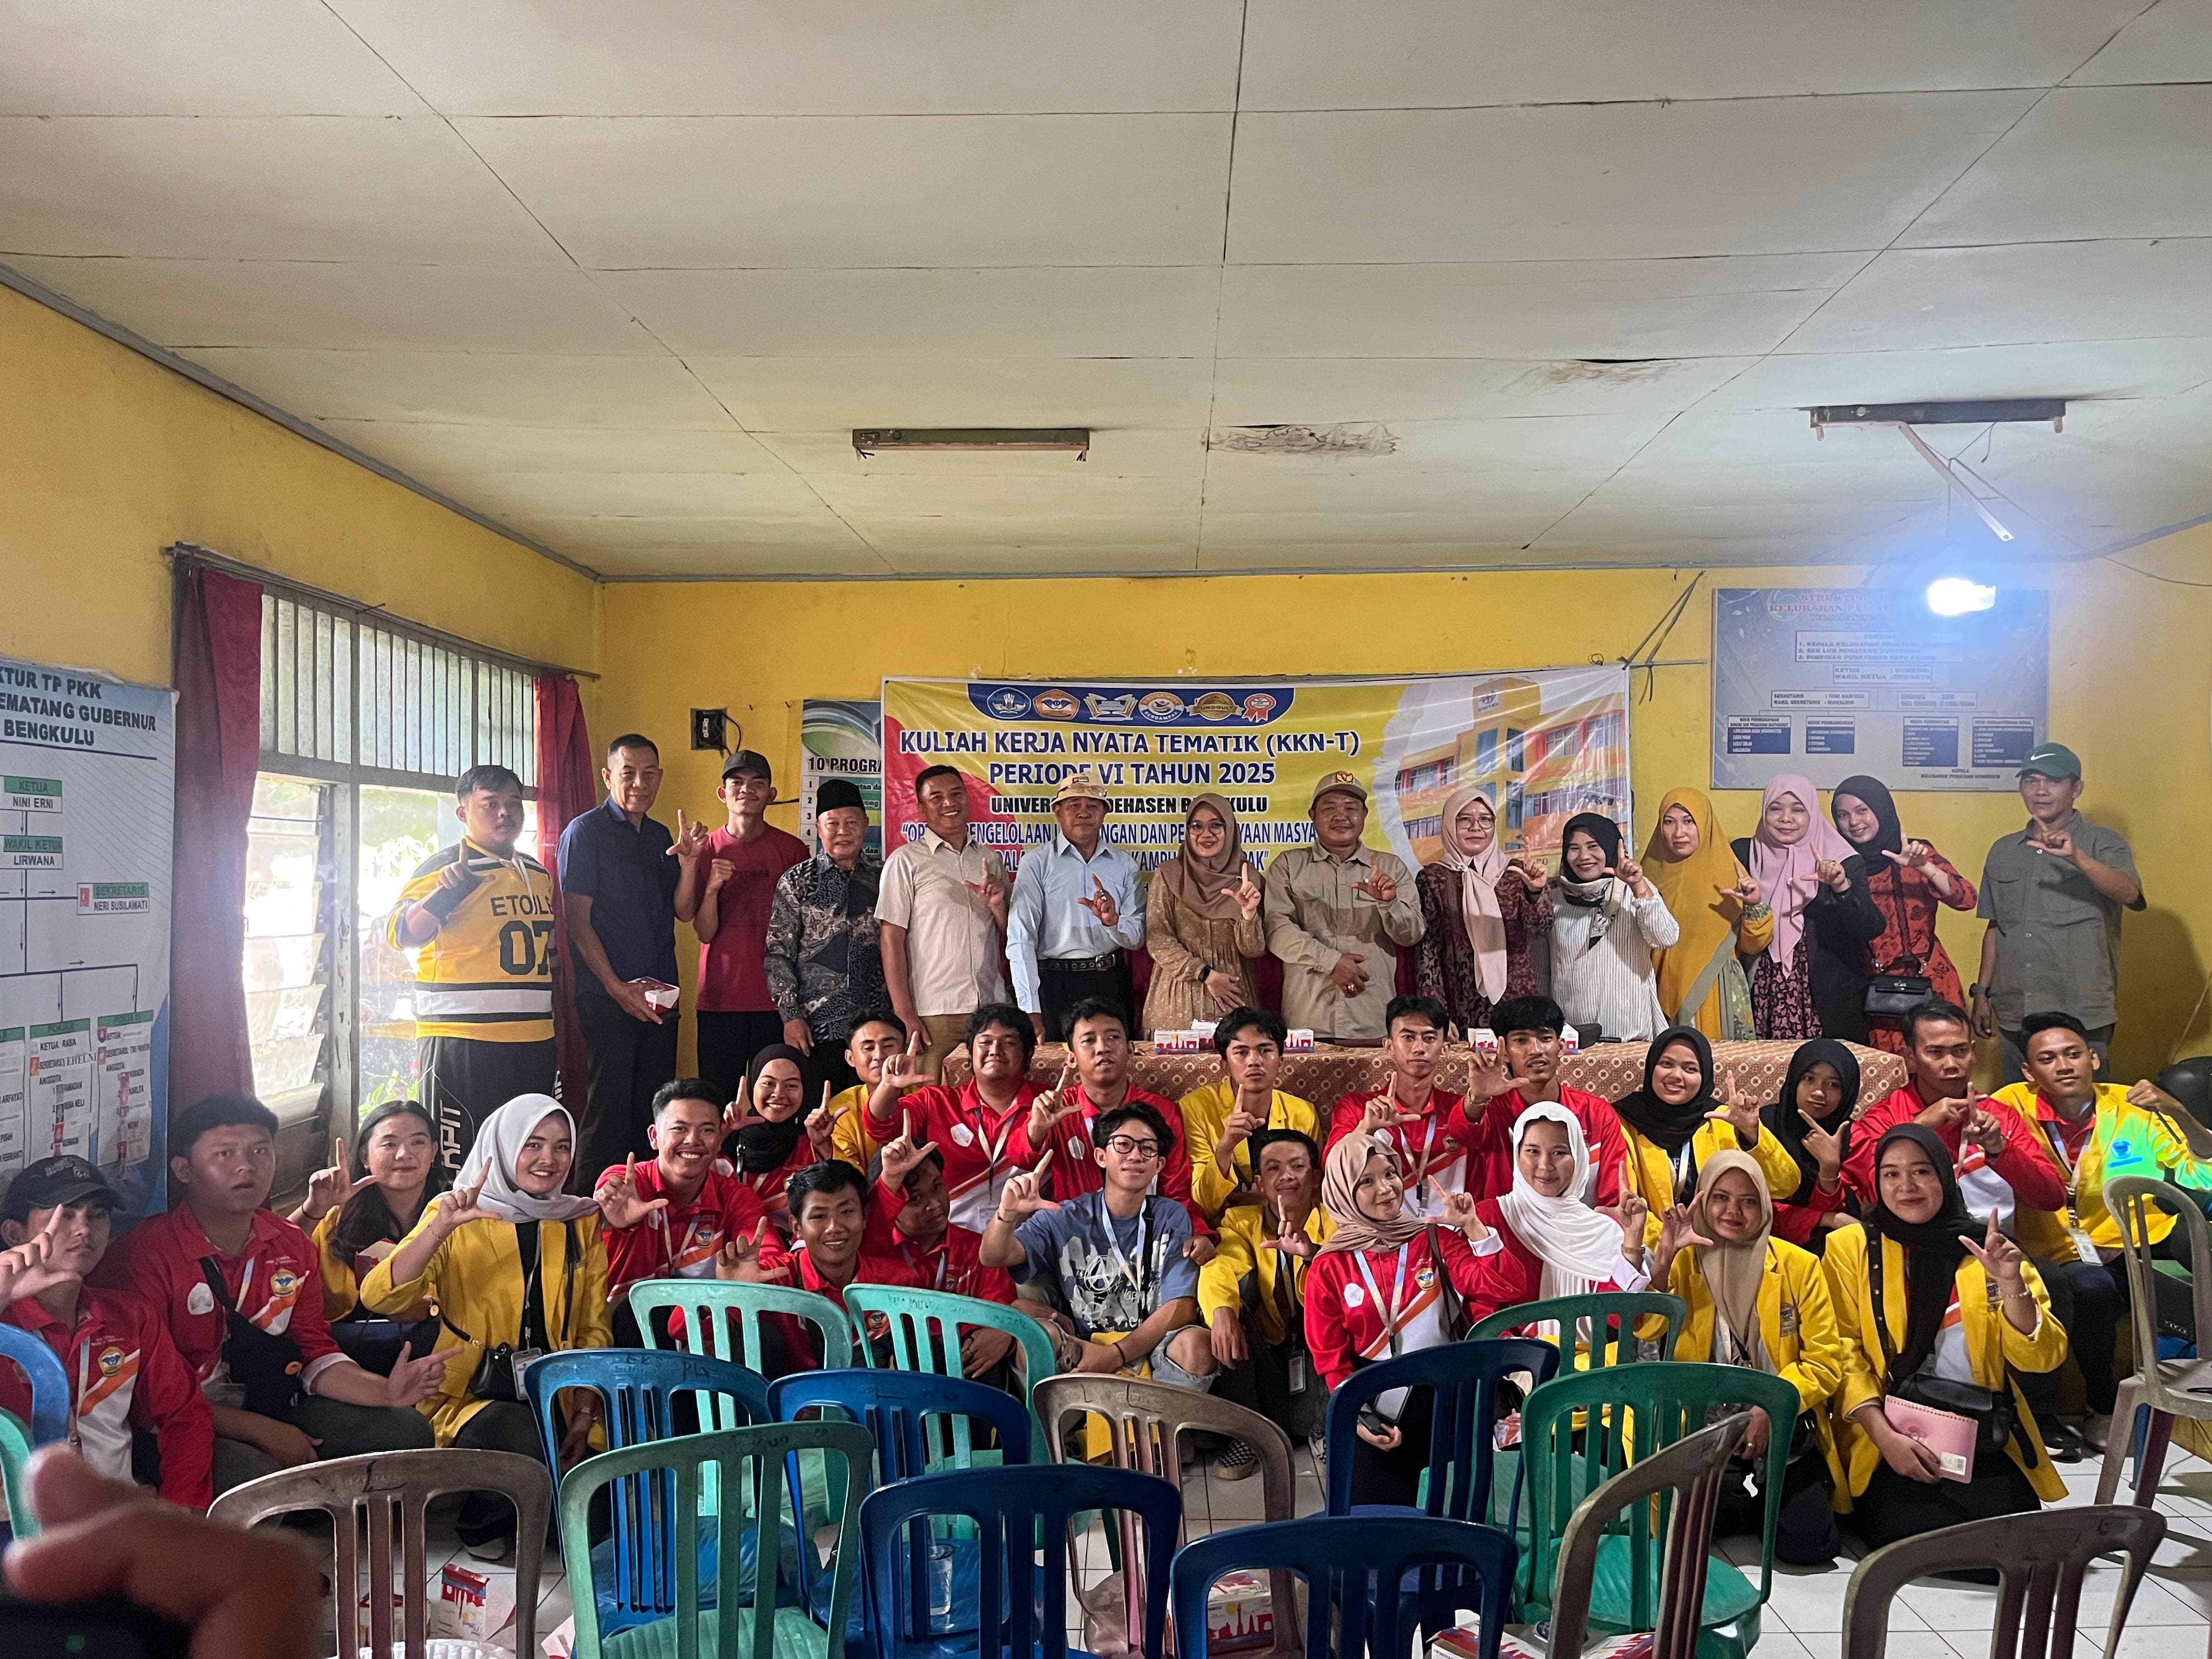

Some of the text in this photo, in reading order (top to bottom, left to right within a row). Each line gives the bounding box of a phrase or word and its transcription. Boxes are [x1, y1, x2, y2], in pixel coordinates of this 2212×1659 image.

[42, 673, 62, 692] TP
[67, 679, 101, 699] PKK
[79, 705, 156, 731] GUBERNUR
[4, 719, 94, 746] BENGKULU
[901, 731, 1359, 758] KULIAH KERJA NYATA TEMATIK (KKN-T)
[809, 757, 825, 770] 10
[1098, 763, 1124, 785] VI
[1130, 763, 1210, 785] TAHUN
[1218, 763, 1274, 784] 2025
[13, 796, 53, 809] NINI ERNI
[1141, 823, 1169, 844] DAN
